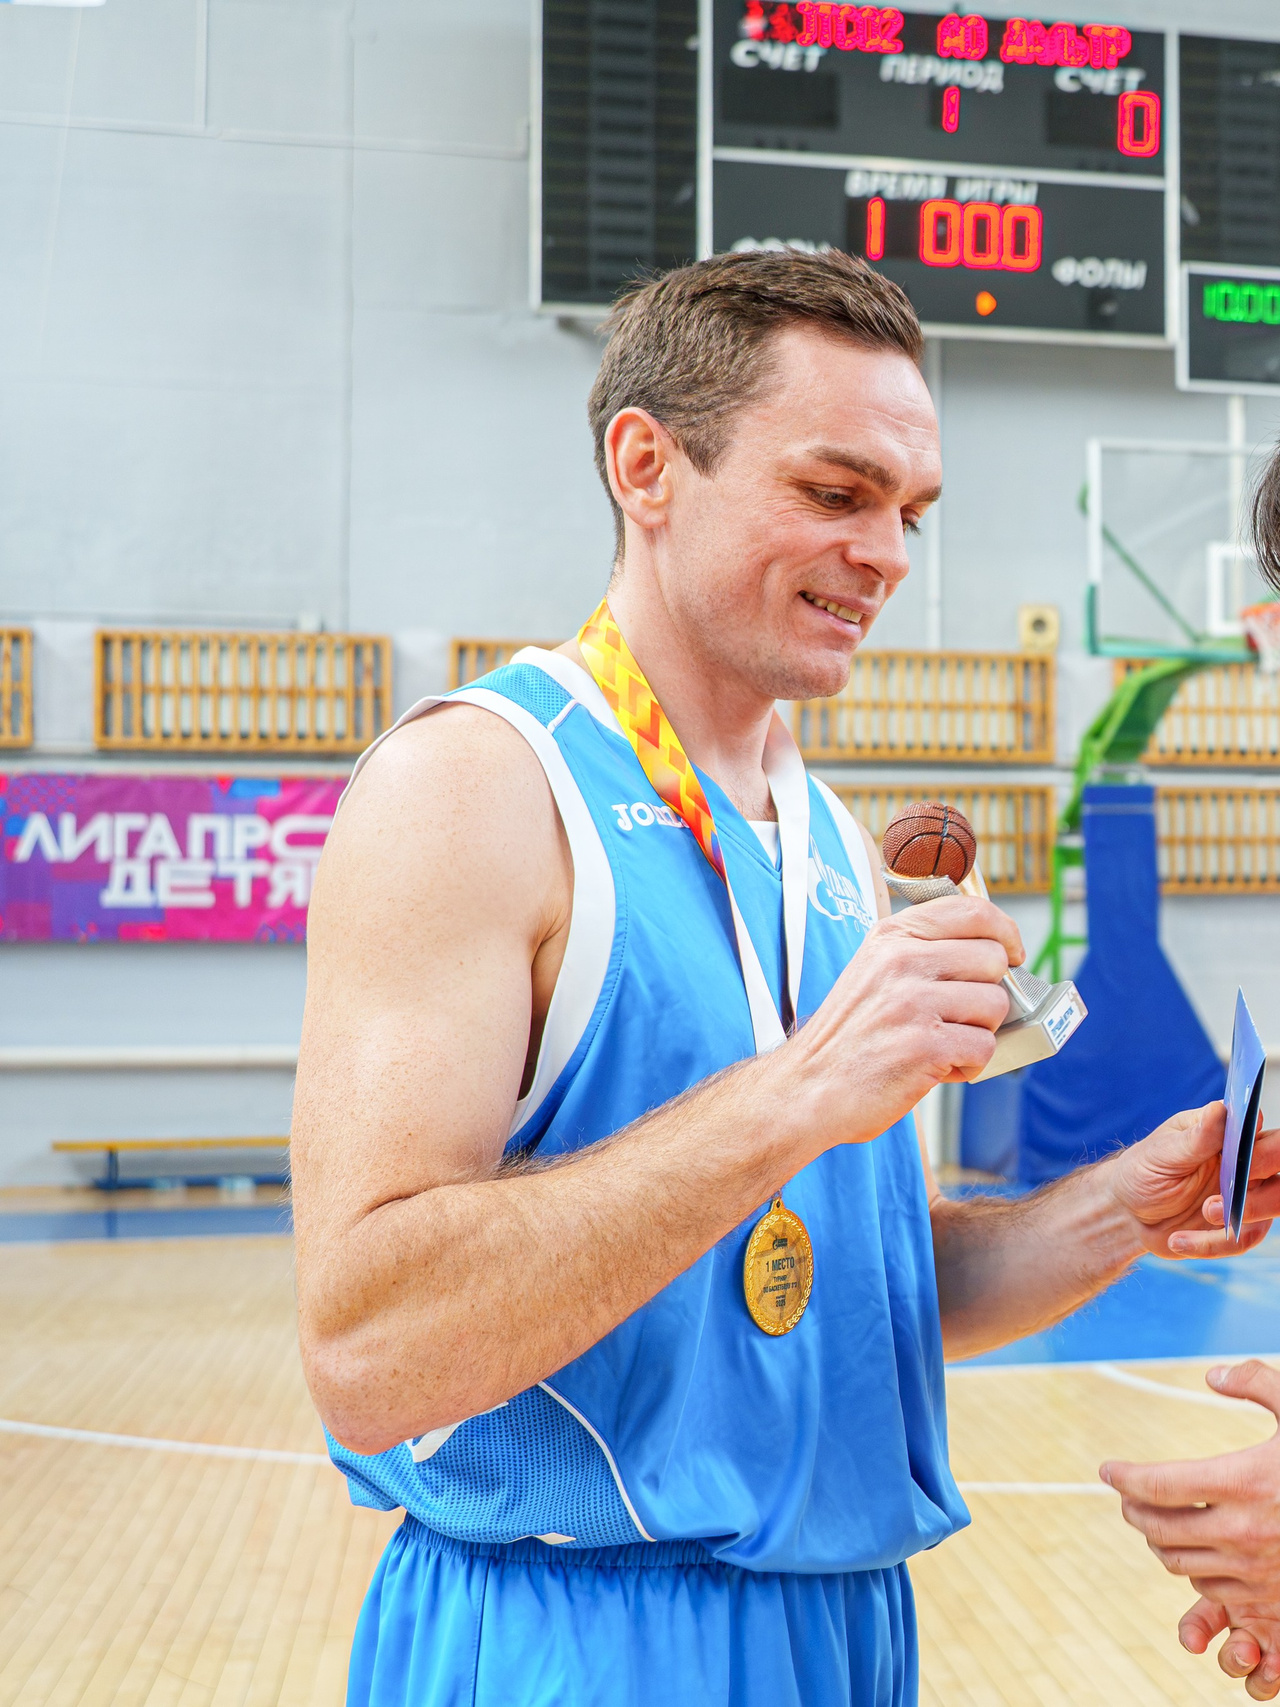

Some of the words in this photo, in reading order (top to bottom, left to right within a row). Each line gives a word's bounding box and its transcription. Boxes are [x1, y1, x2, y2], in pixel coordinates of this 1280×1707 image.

[880, 54, 1004, 94] ПЕРИОД
[1117, 90, 1160, 157] 0
[845, 170, 948, 200] ВРЕМЯ
[953, 176, 1039, 206] ИГРЫ
[1052, 256, 1148, 290] ФОЛЫ
[100, 857, 319, 909] ДЕТЯ
[766, 1260, 770, 1272] 1
[771, 1256, 795, 1271] МЕСТО
